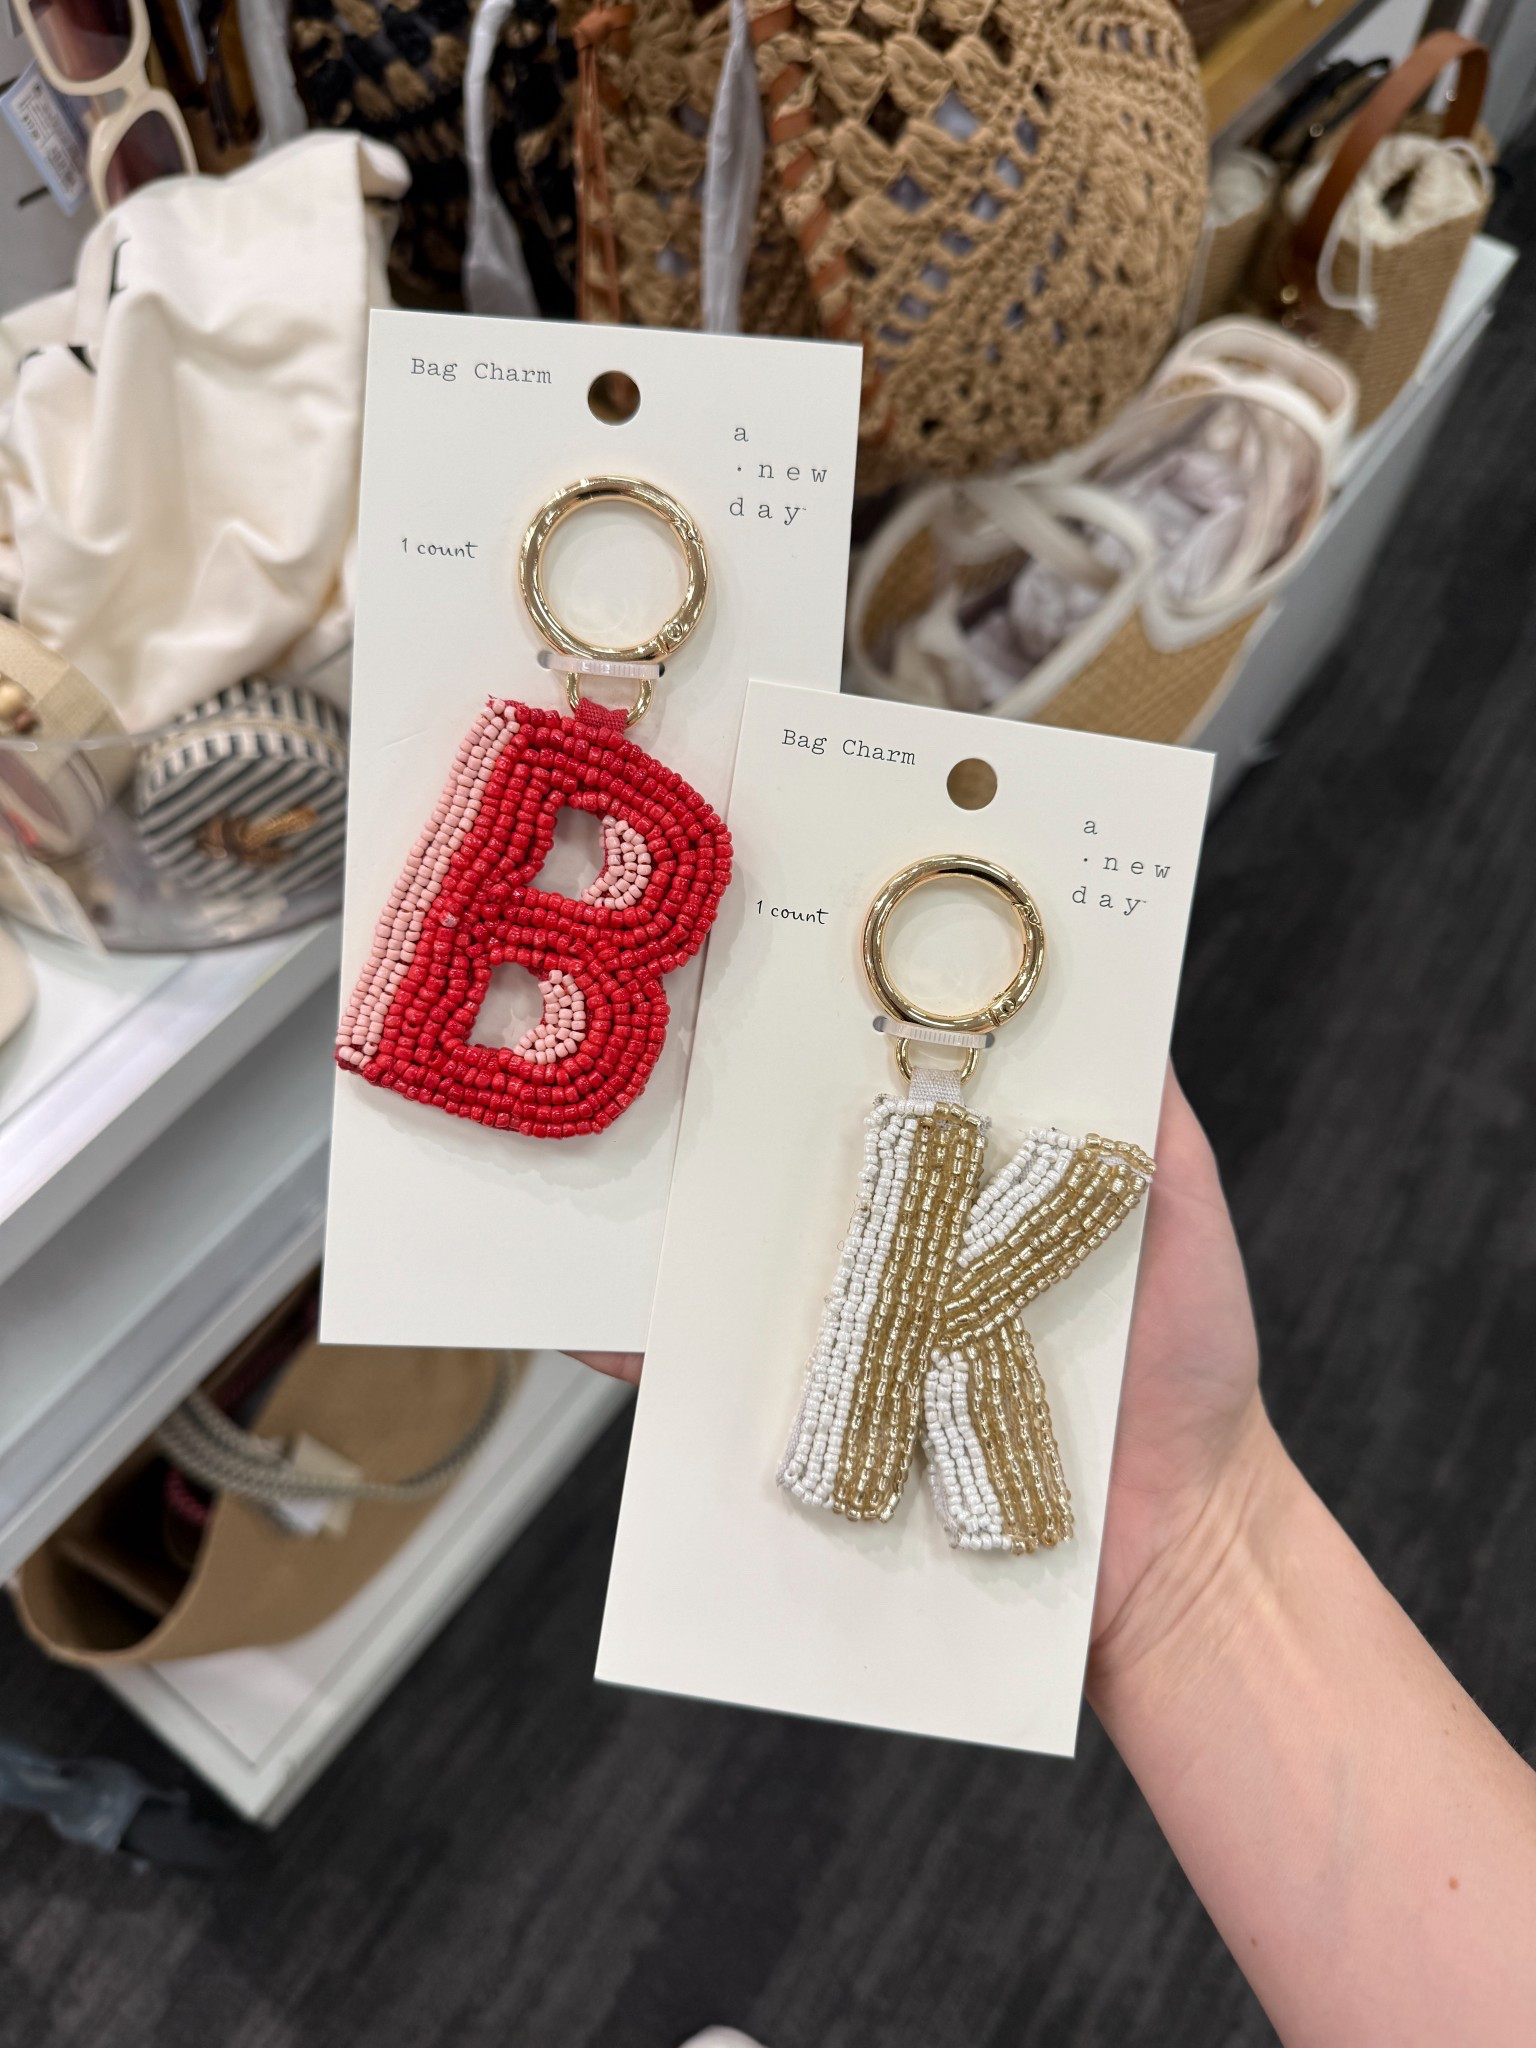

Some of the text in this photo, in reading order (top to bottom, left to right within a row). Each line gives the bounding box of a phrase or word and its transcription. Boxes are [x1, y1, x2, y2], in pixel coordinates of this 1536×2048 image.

[410, 357, 553, 384] Bag Charm
[733, 426, 750, 443] a
[757, 460, 828, 484] new
[728, 497, 800, 526] day
[401, 537, 479, 560] 1 count
[781, 728, 917, 766] Bag Charm
[1083, 819, 1099, 836] a
[1102, 855, 1172, 880] new
[755, 899, 830, 925] 1 count
[1071, 885, 1140, 917] day
[335, 696, 733, 1138] B
[777, 1095, 1156, 1554] K
